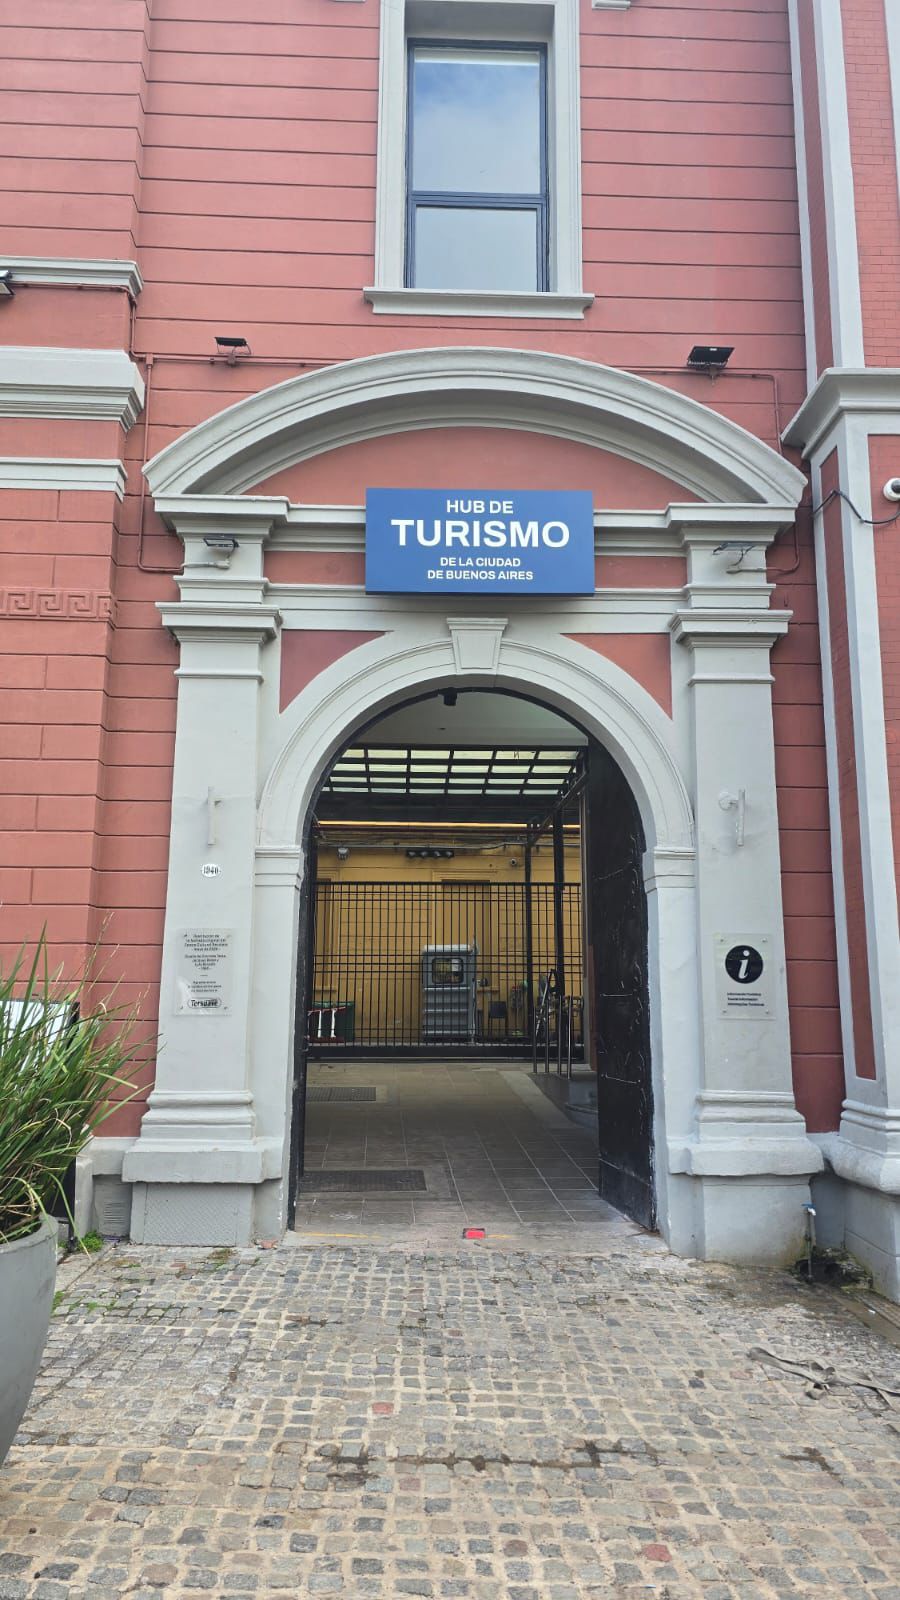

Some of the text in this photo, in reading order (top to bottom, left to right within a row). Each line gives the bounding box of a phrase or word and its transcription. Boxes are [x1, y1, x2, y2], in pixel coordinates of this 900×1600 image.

[446, 499, 514, 514] HUB DE
[390, 519, 570, 548] TURISMO
[440, 557, 521, 567] DE LA CIUDAD
[427, 570, 534, 581] DE BUENOS AIRES
